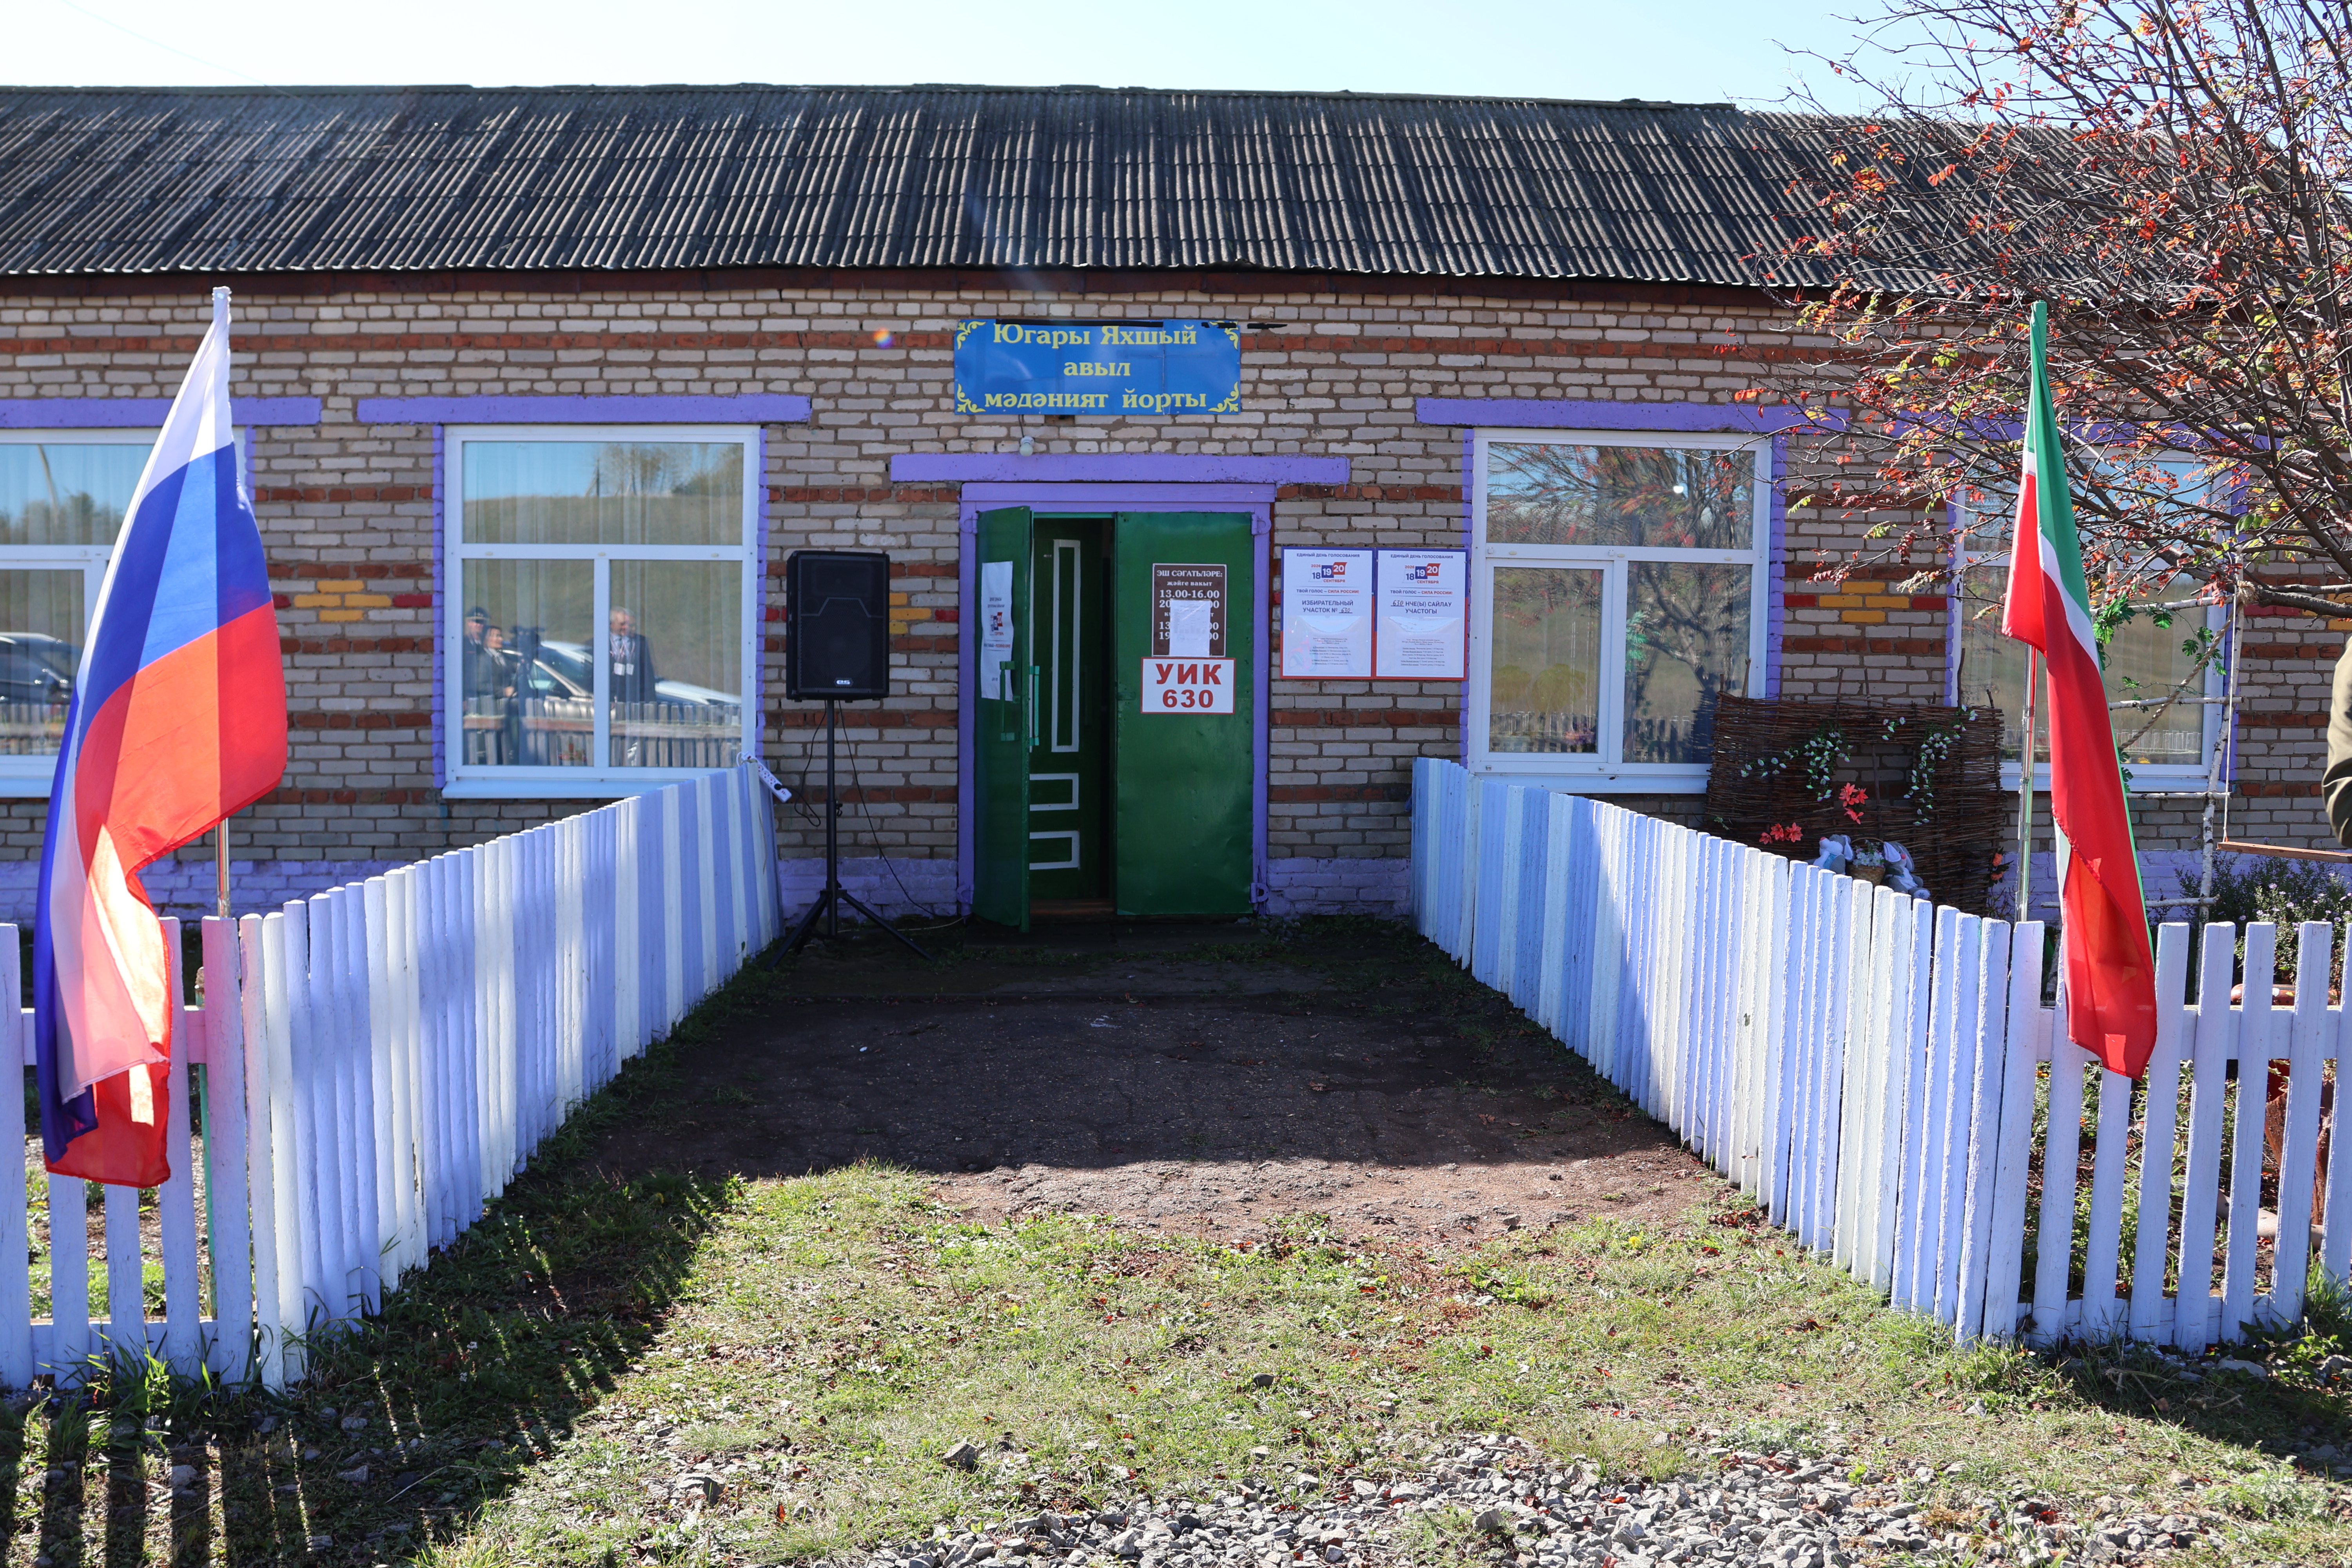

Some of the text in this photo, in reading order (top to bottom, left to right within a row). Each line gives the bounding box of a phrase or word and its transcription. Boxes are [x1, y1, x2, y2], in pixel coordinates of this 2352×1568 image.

[994, 323, 1196, 348] Югары Яхшый
[1064, 362, 1131, 376] авыл
[984, 388, 1206, 412] мәдәният йорты
[1160, 590, 1220, 598] 13.00-16.00
[1155, 664, 1221, 685] УИК
[1162, 689, 1214, 708] 630
